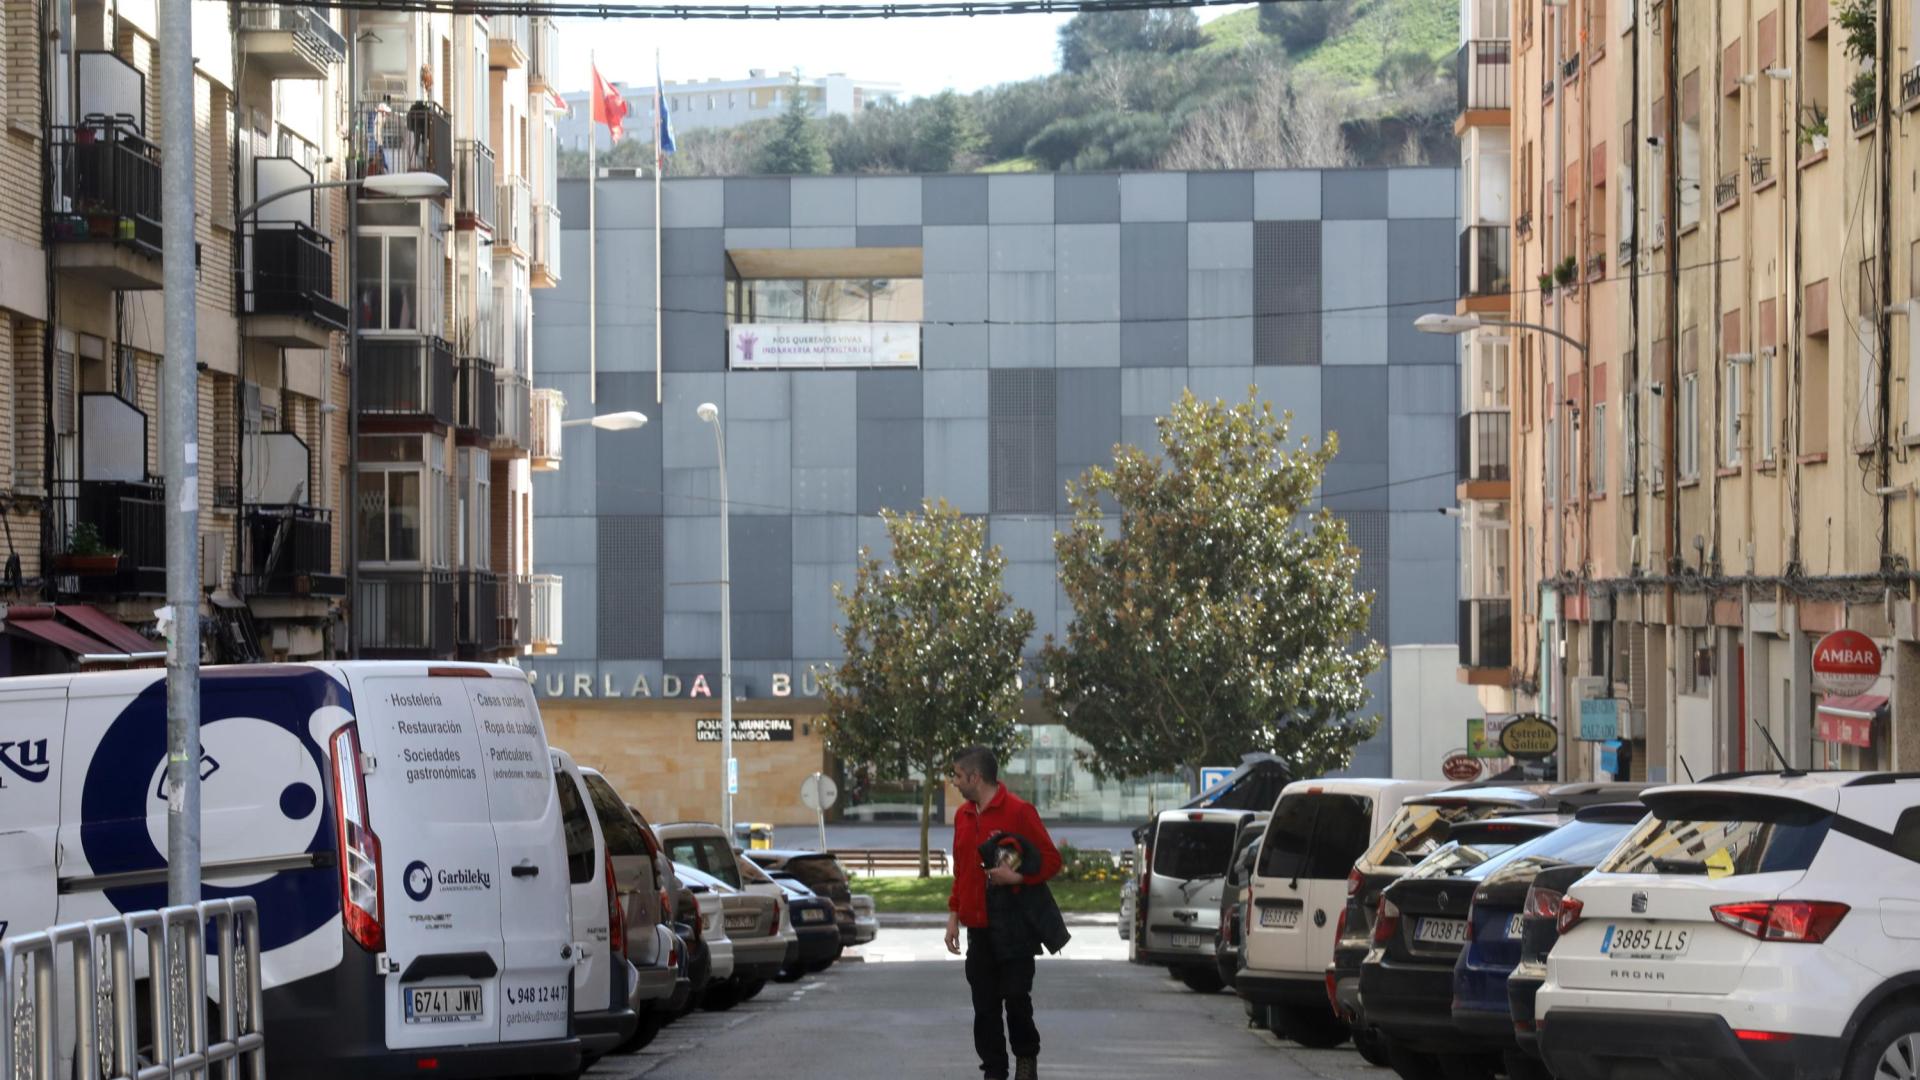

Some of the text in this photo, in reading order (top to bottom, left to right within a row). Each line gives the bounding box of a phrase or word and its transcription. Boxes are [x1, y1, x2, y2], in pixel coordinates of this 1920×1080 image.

[773, 336, 791, 344] NOS
[792, 336, 836, 345] QUEREMOS
[1819, 648, 1875, 665] AMBAR
[528, 670, 711, 697] URLADA
[476, 693, 526, 708] Casas rurales
[398, 720, 462, 734] Restauración
[484, 720, 538, 738] Ropa de trabajo
[738, 719, 792, 731] MUNICIPAL
[1509, 728, 1551, 739] Estrella
[1510, 738, 1549, 750] Galicia
[403, 748, 461, 762] Sociedades
[490, 747, 533, 761] Particulares
[407, 766, 477, 784] gastronómicas
[437, 868, 491, 889] Garbileku
[1423, 918, 1451, 939] 7038
[1612, 929, 1687, 951] 3885 LLS
[1610, 969, 1665, 980] ARONA
[414, 989, 479, 1014] 6741 JWV
[518, 986, 536, 1003] 948
[538, 986, 548, 1002] 12
[550, 985, 560, 1001] 44
